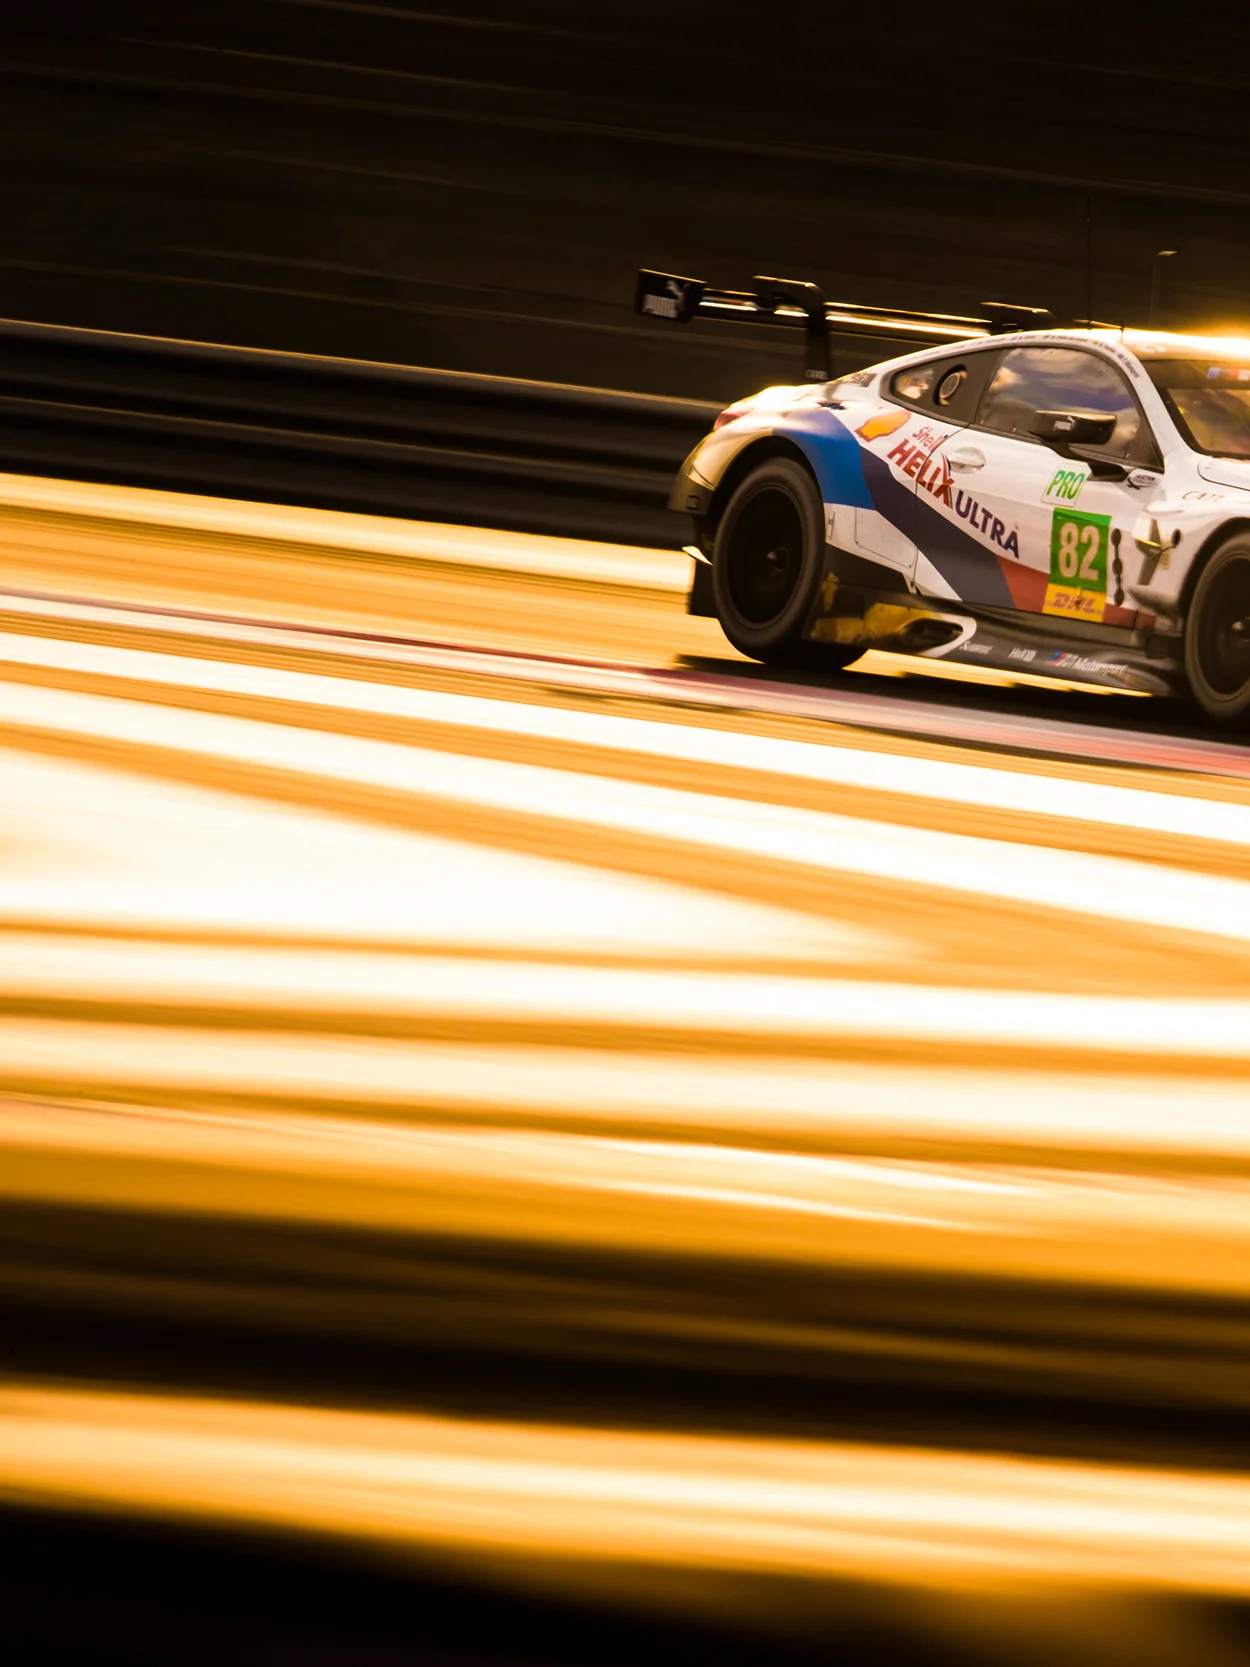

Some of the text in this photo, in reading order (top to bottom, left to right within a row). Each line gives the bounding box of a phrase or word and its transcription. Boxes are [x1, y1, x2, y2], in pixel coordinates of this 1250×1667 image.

[912, 426, 944, 452] Shell
[886, 438, 1020, 559] HELIX ULTRA
[1046, 469, 1087, 500] PRO
[1058, 521, 1100, 581] 82
[1053, 591, 1096, 614] DHL
